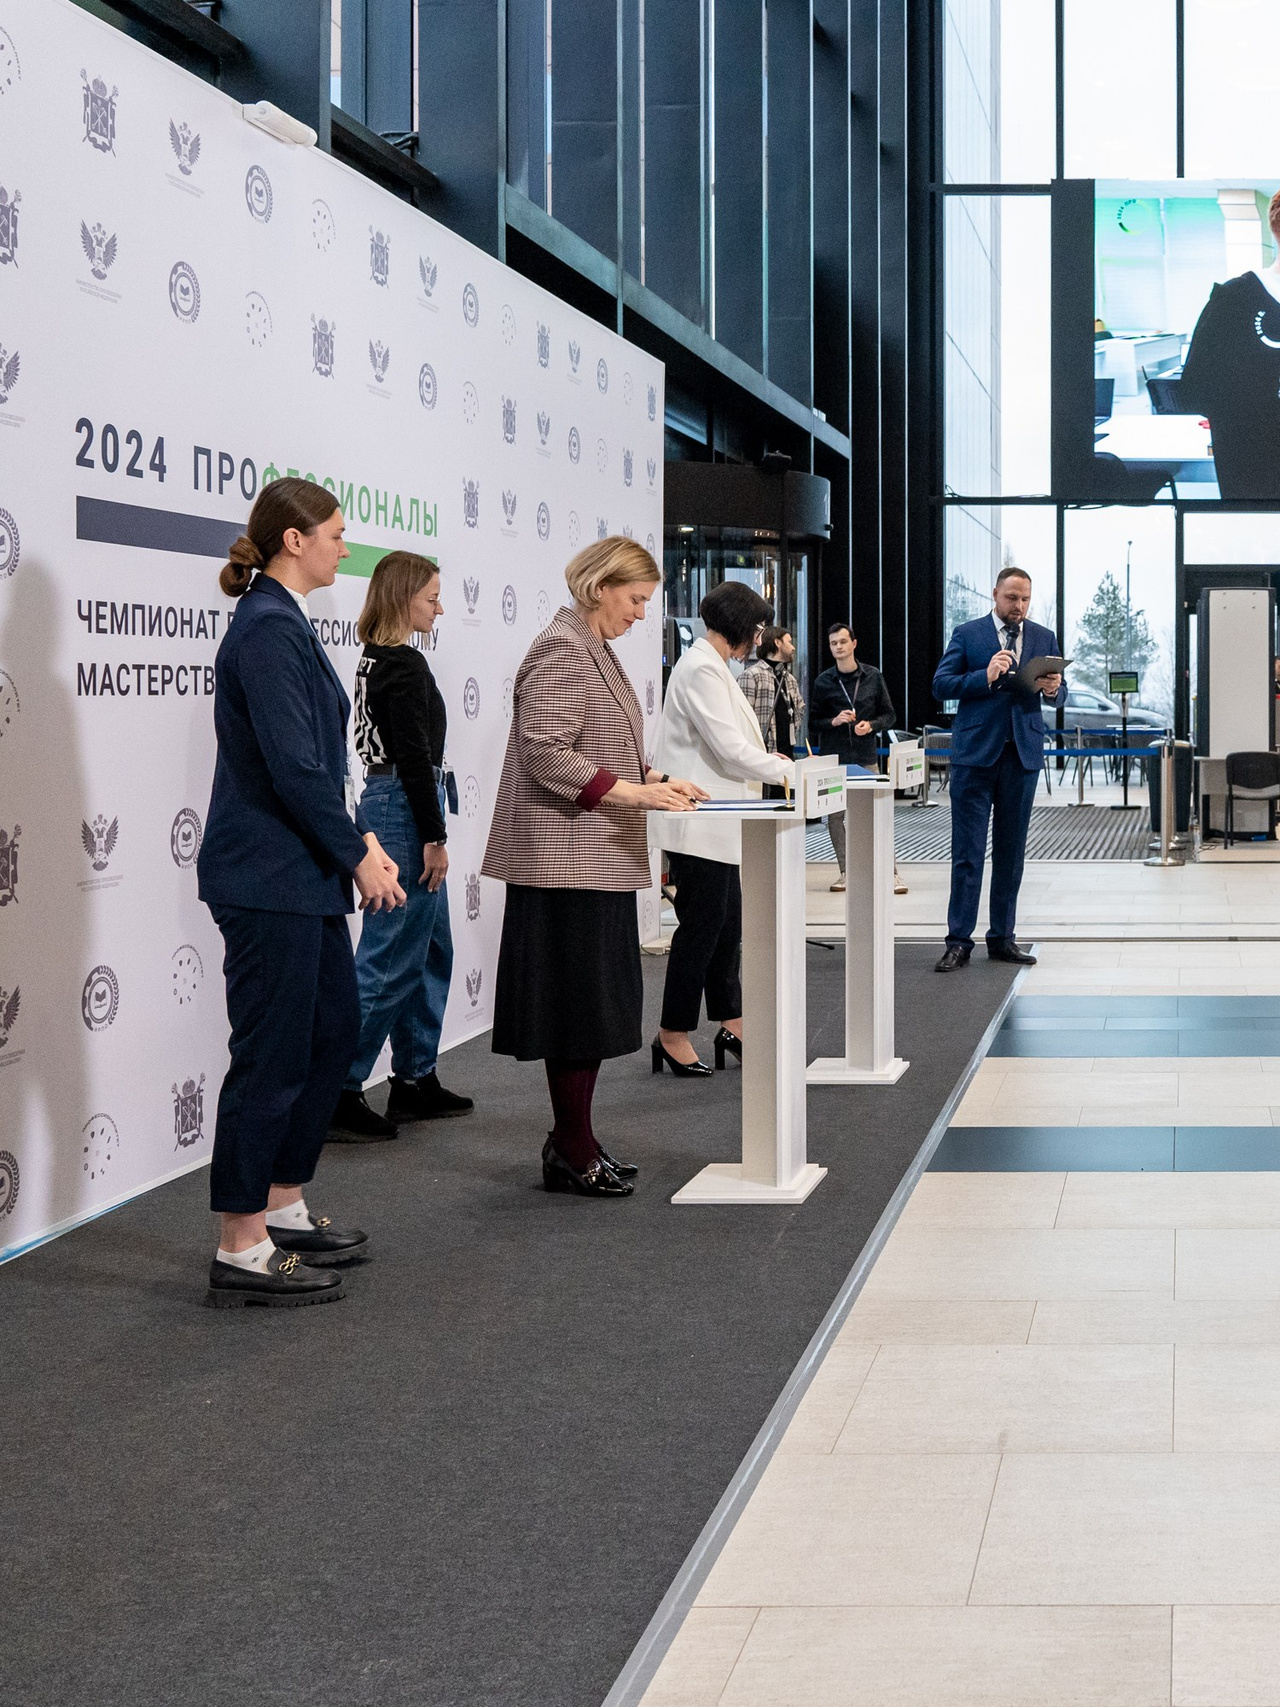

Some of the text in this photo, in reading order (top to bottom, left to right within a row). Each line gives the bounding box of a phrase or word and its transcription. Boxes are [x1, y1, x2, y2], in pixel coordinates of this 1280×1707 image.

[75, 417, 438, 538] 2024 ПРОИОНАЛЫ
[77, 599, 220, 640] ЧЕМПИОНАТ
[77, 662, 215, 697] МАСТЕРСТВ
